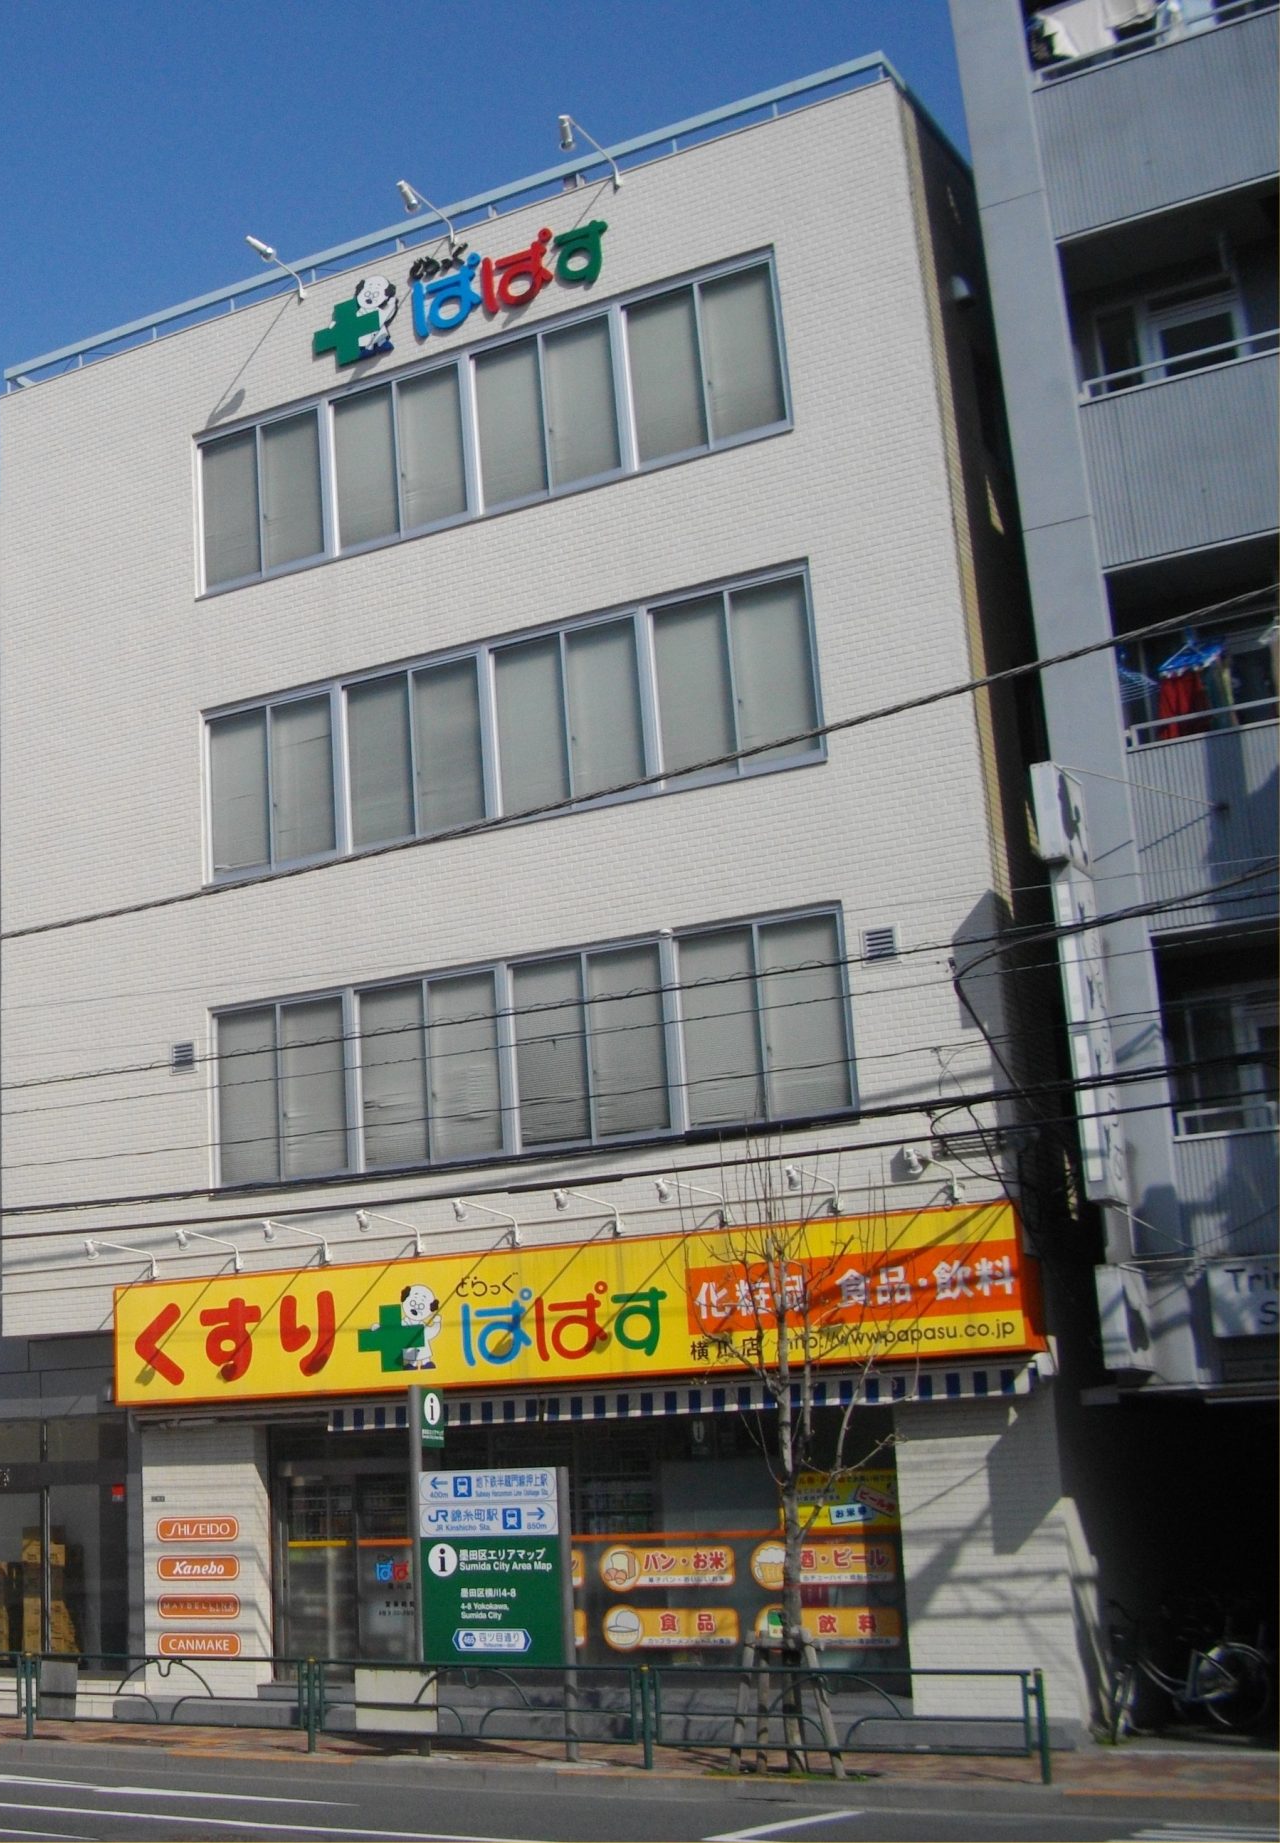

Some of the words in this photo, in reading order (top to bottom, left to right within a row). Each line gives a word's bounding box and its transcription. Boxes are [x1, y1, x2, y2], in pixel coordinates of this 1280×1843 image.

[411, 220, 608, 338] ぱぱす
[456, 1272, 518, 1297] どらっぐ
[135, 1290, 335, 1386] くすり
[461, 1281, 667, 1366] ぱぱす
[690, 1337, 763, 1361] 横川店
[430, 1491, 449, 1499] 400m
[428, 1509, 448, 1522] JR
[451, 1508, 498, 1522] 錦糸町駅
[166, 1522, 231, 1537] SHISEIDO
[527, 1522, 547, 1530] 850m
[459, 1548, 546, 1561] 墨田区エリアマップ
[644, 1551, 726, 1571] パン・お米
[173, 1560, 225, 1575] Kanebo
[459, 1562, 491, 1571] Sumida
[493, 1561, 510, 1572] City
[512, 1561, 532, 1570] Area
[533, 1561, 552, 1572] Map
[460, 1588, 517, 1598] 墨田区横川4-8
[163, 1602, 235, 1610] MAYBELLINE
[473, 1603, 510, 1611] Yokokawa,
[488, 1612, 502, 1620] City
[169, 1639, 230, 1651] CANMAKE
